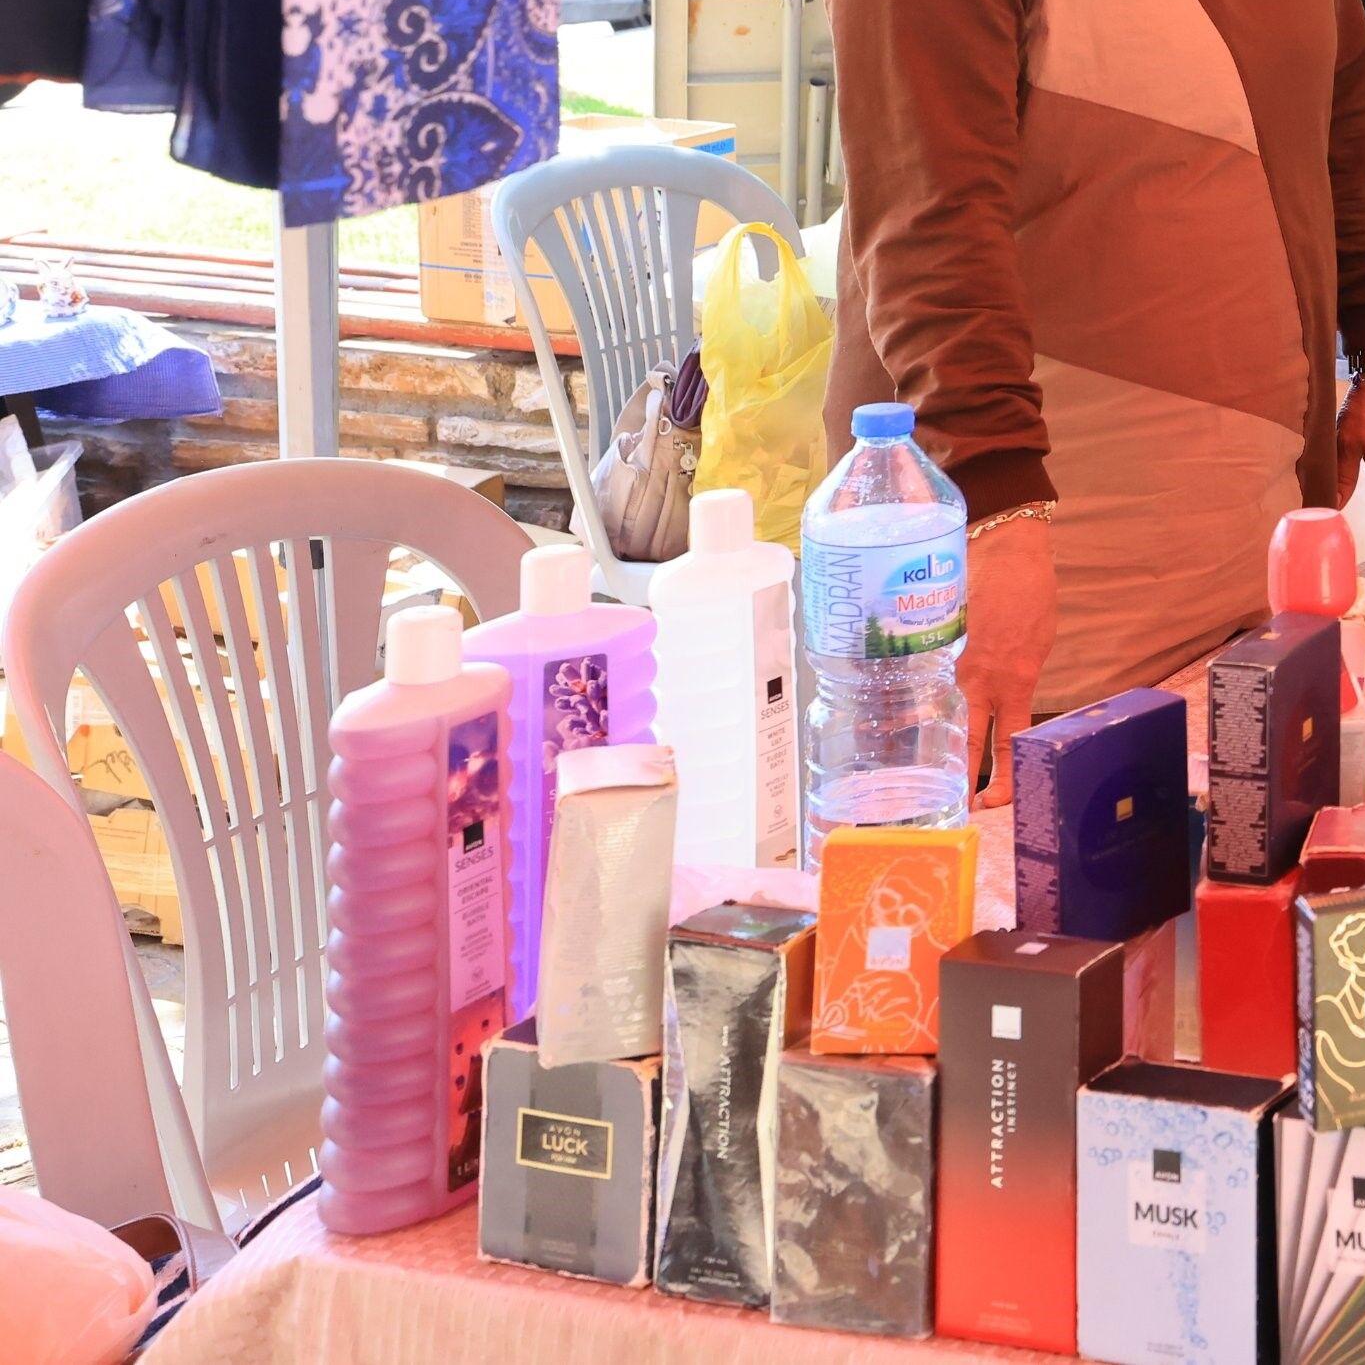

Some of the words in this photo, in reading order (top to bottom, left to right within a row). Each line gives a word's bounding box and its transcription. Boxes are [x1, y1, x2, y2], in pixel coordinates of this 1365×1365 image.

[828, 552, 862, 654] MADRAN
[760, 700, 790, 720] SENSES
[455, 846, 494, 873] SENSES
[716, 1053, 731, 1160] ATTRACTION
[1007, 1062, 1017, 1133] INSTINCT
[549, 1124, 582, 1137] AVON
[991, 1058, 1004, 1189] ATTRACTION
[541, 1133, 589, 1157] LUCK
[1134, 1201, 1199, 1230] MUSK
